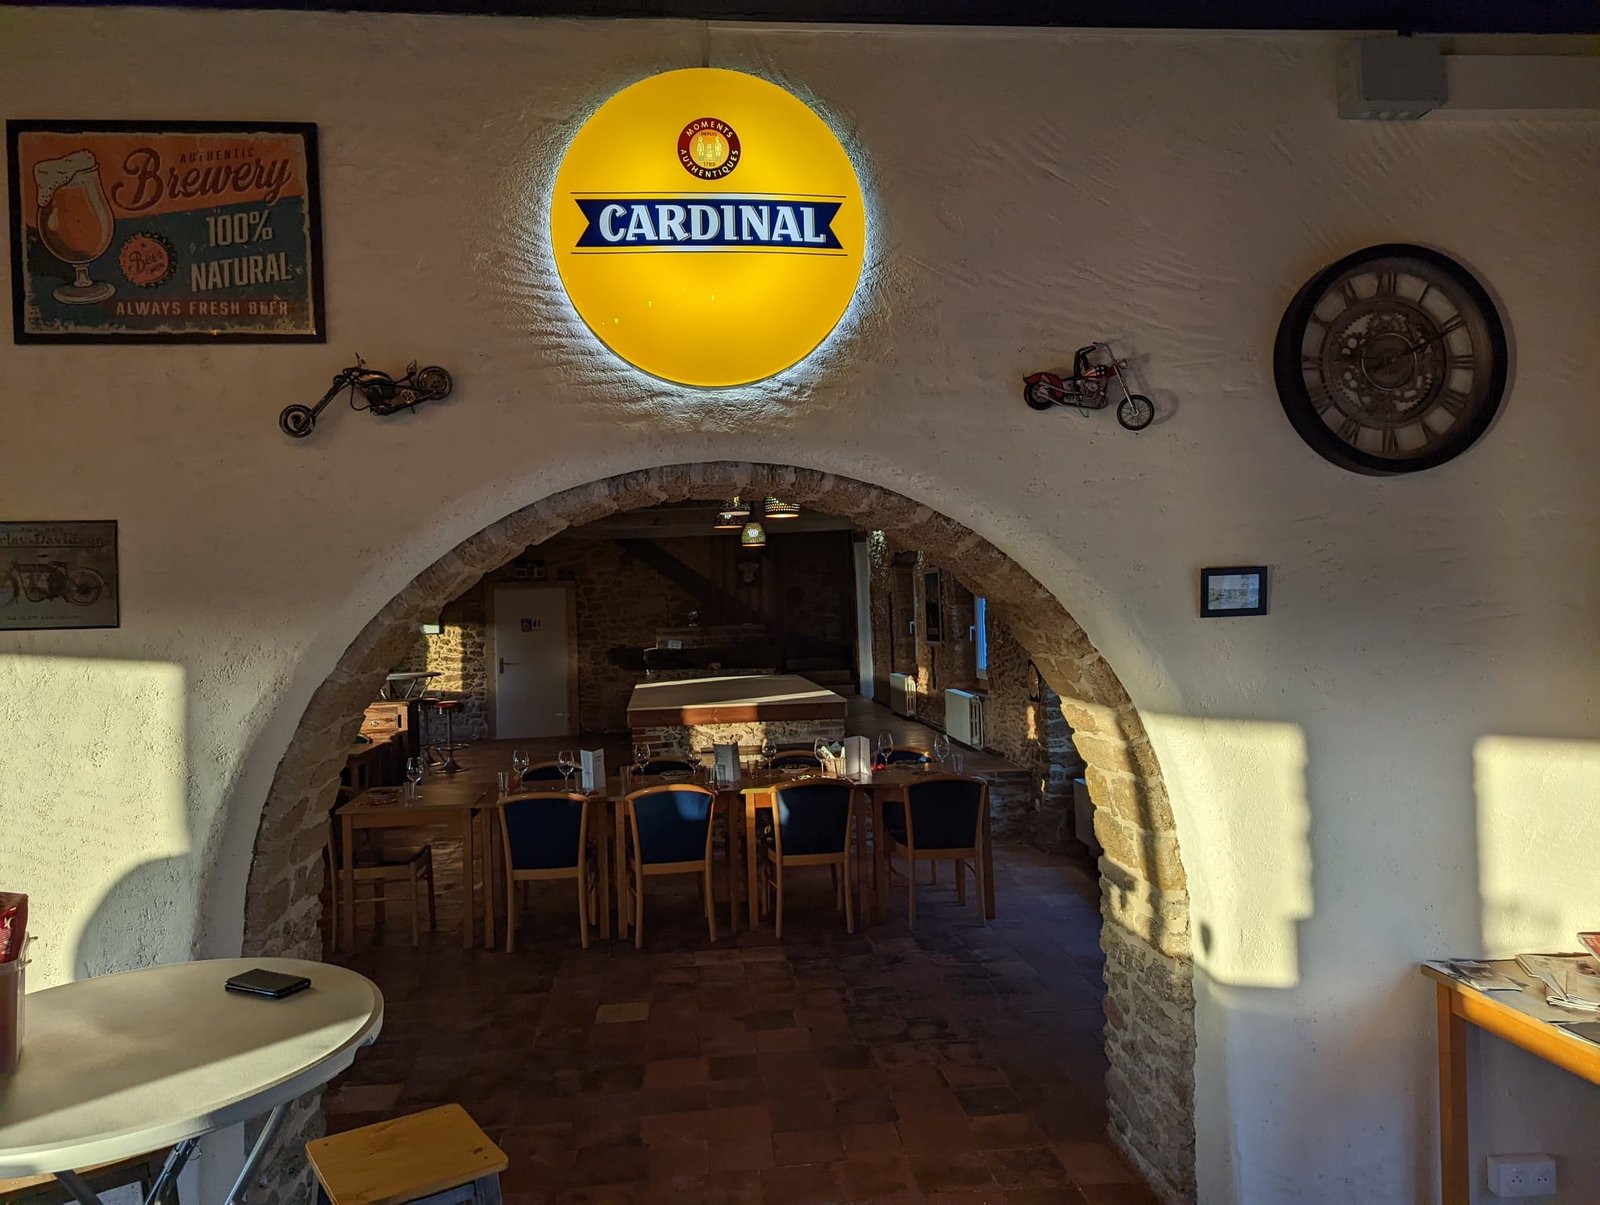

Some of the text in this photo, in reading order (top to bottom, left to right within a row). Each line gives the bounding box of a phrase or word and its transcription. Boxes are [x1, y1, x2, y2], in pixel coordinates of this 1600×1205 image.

[686, 121, 733, 138] MOMENTS
[180, 147, 254, 164] AUTHENTIC
[680, 149, 739, 178] AUTHENTIQUES
[111, 147, 291, 211] Brewery
[205, 209, 273, 247] 100%
[598, 203, 827, 244] CARDINAL
[190, 252, 292, 293] NATURAL
[116, 301, 288, 316] ALWAYS FRESH BEER
